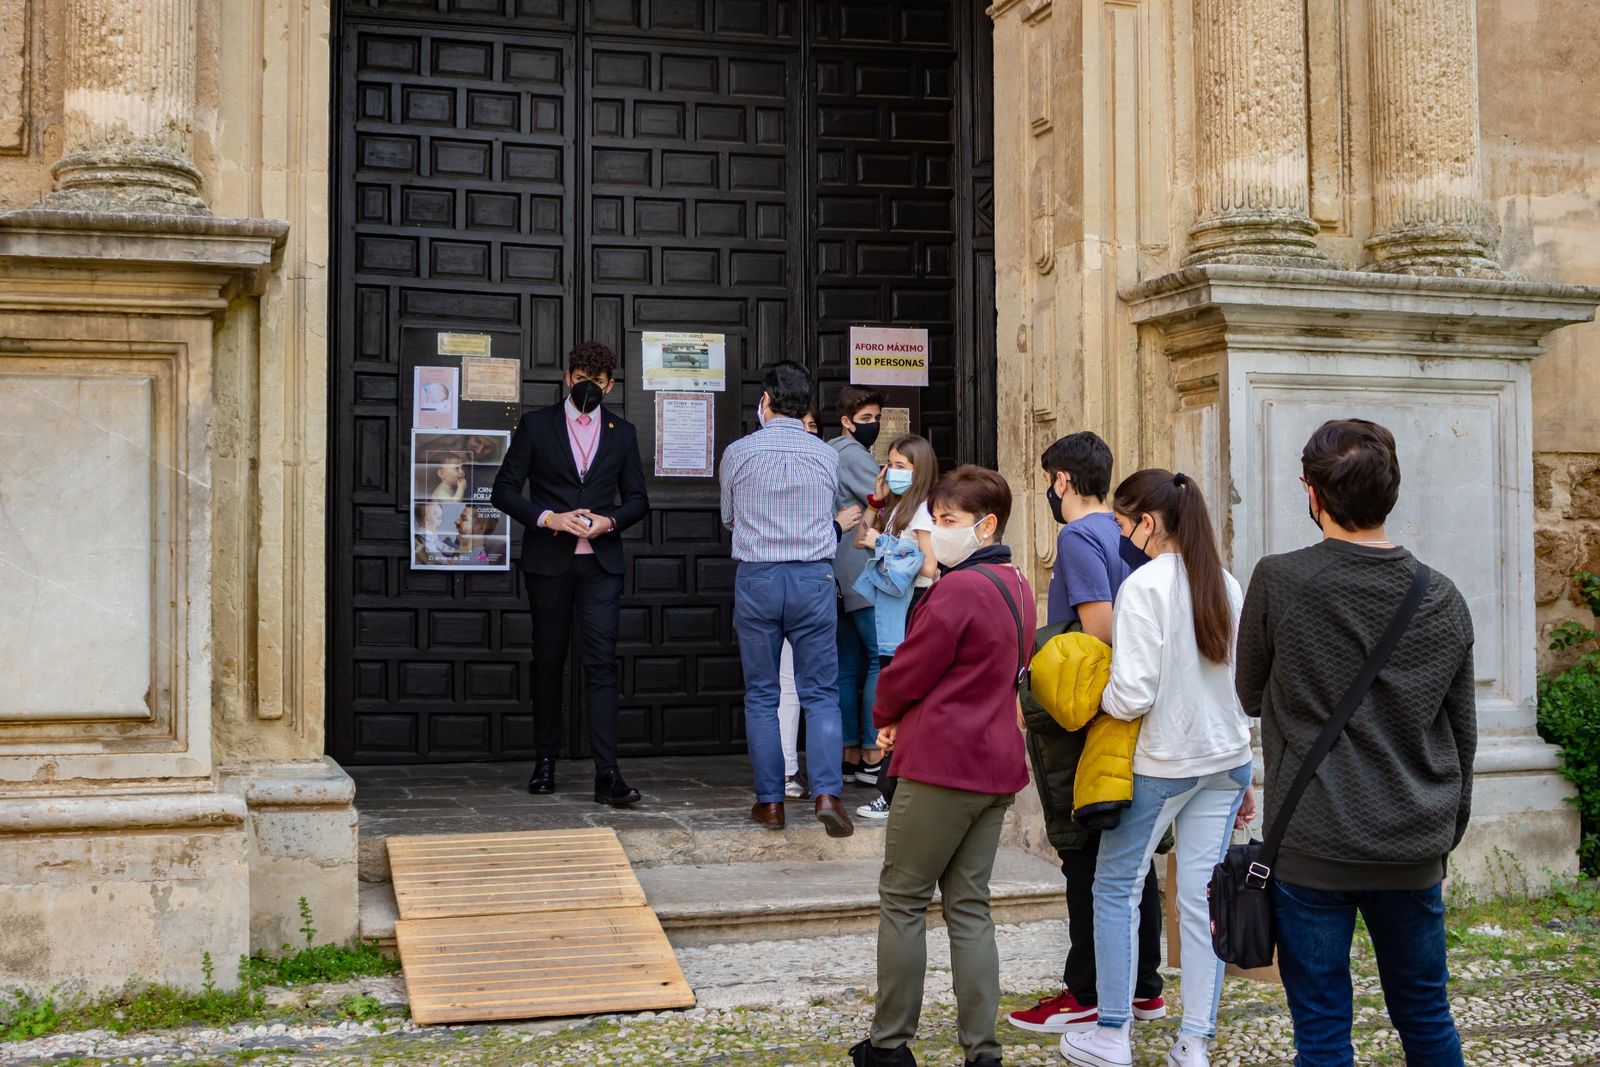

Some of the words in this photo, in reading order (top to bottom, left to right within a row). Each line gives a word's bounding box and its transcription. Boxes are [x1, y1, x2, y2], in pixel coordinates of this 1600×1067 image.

[855, 343, 884, 351] AFORO
[886, 342, 924, 352] MÁXIMO
[855, 357, 872, 366] 100
[874, 358, 925, 368] PERSONAS
